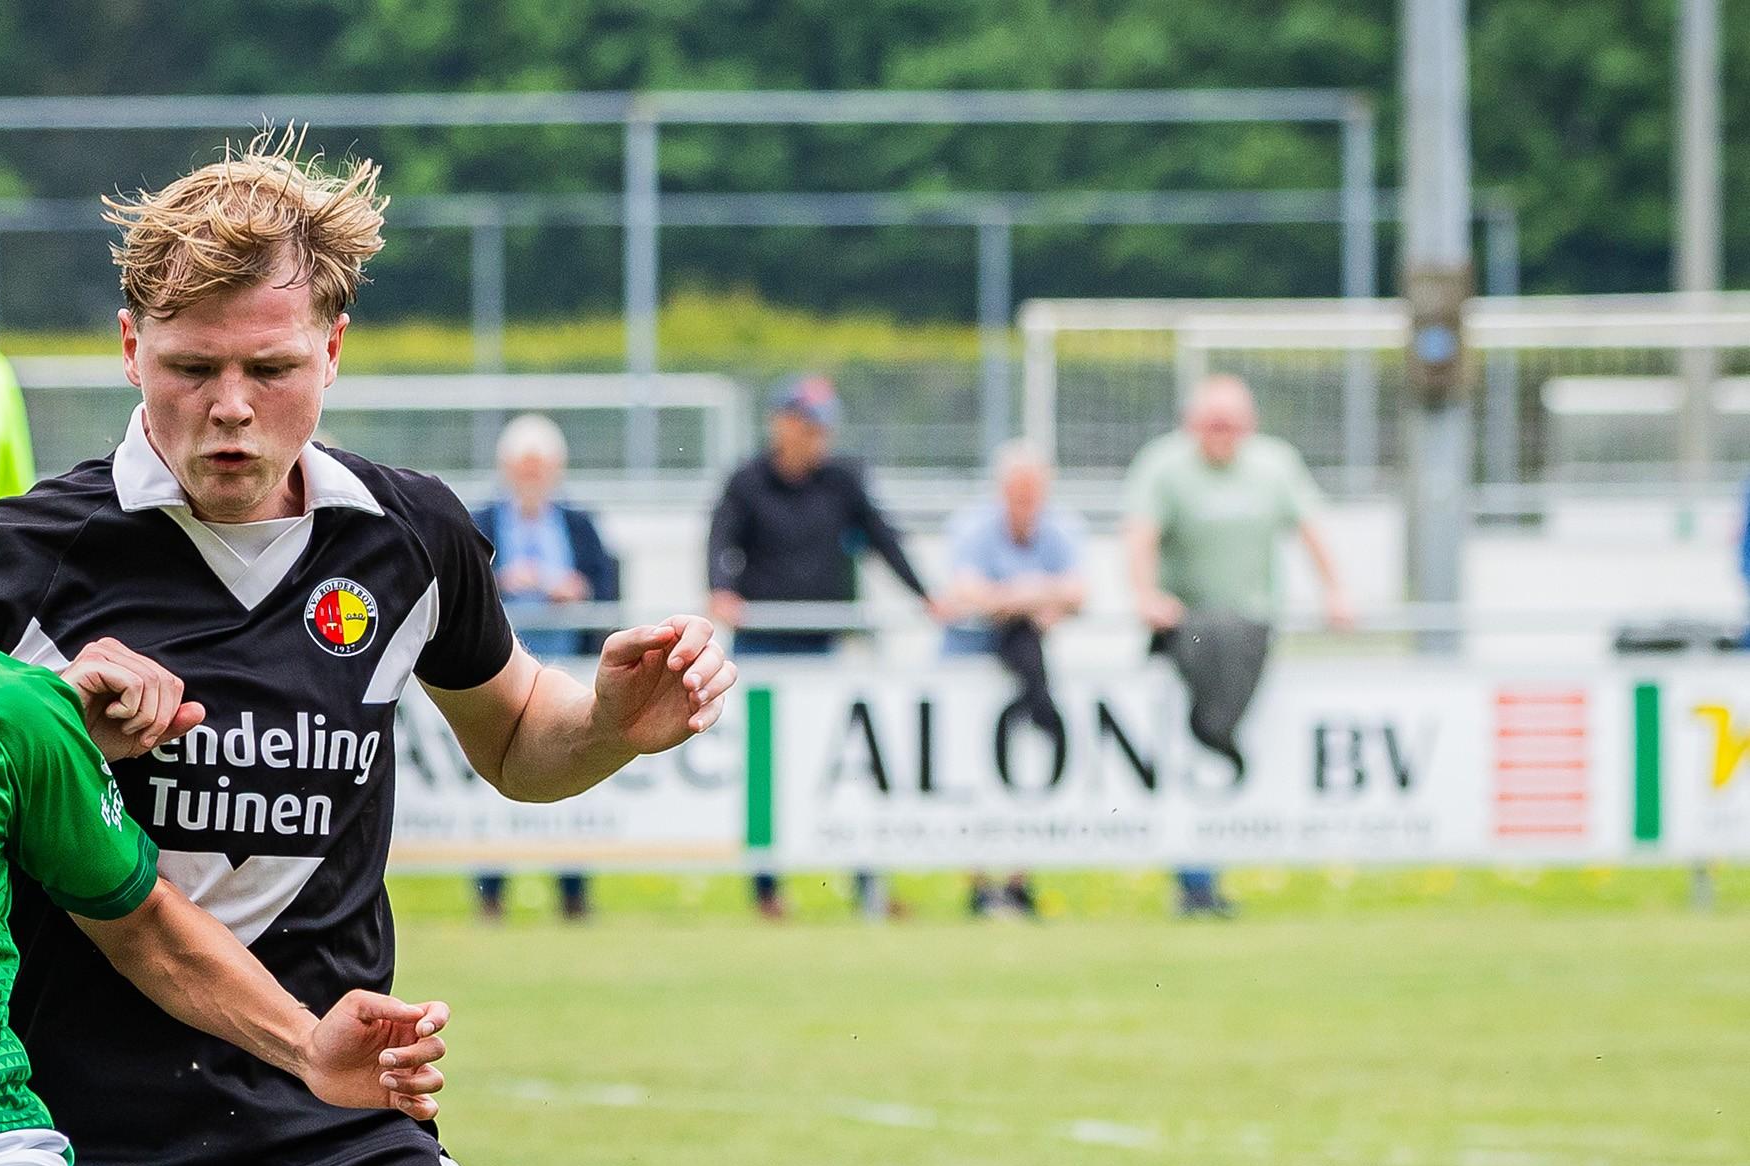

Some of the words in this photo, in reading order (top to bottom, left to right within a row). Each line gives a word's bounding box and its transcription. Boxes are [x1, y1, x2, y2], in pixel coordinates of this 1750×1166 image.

[319, 582, 355, 596] ROLDER
[356, 590, 375, 613] BOYS
[333, 644, 356, 653] 1927
[151, 711, 381, 784] endeling
[149, 775, 333, 835] Tuinen
